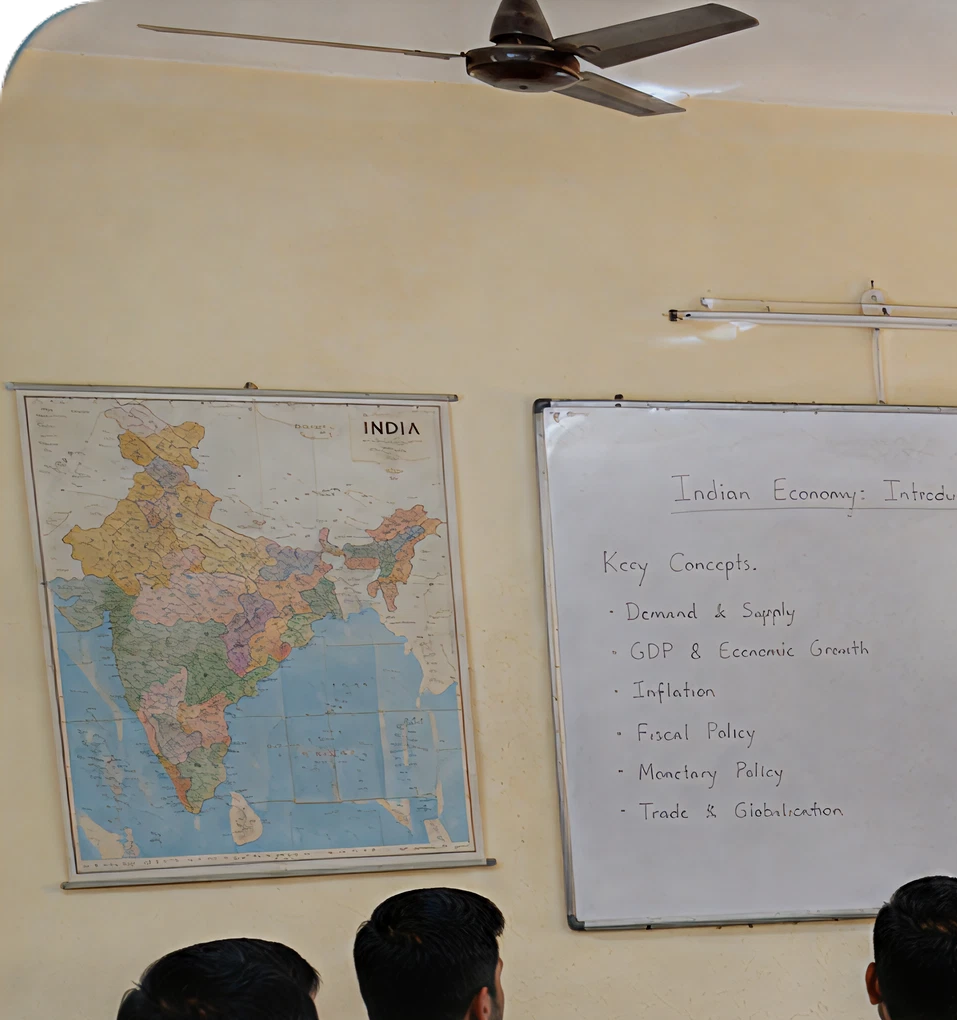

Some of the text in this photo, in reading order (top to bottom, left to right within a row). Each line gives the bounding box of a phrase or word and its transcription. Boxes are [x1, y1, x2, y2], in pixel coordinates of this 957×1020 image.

[363, 421, 420, 436] INDIA
[671, 474, 751, 502] Indian
[773, 477, 866, 517] Economy:
[625, 601, 698, 621] Demand
[714, 602, 727, 619] &
[630, 641, 674, 661] GDP
[690, 642, 702, 660] &
[632, 679, 716, 704] Inflation
[637, 721, 756, 749] Fiscal Policy
[638, 802, 689, 820] Trade
[705, 803, 717, 819] &
